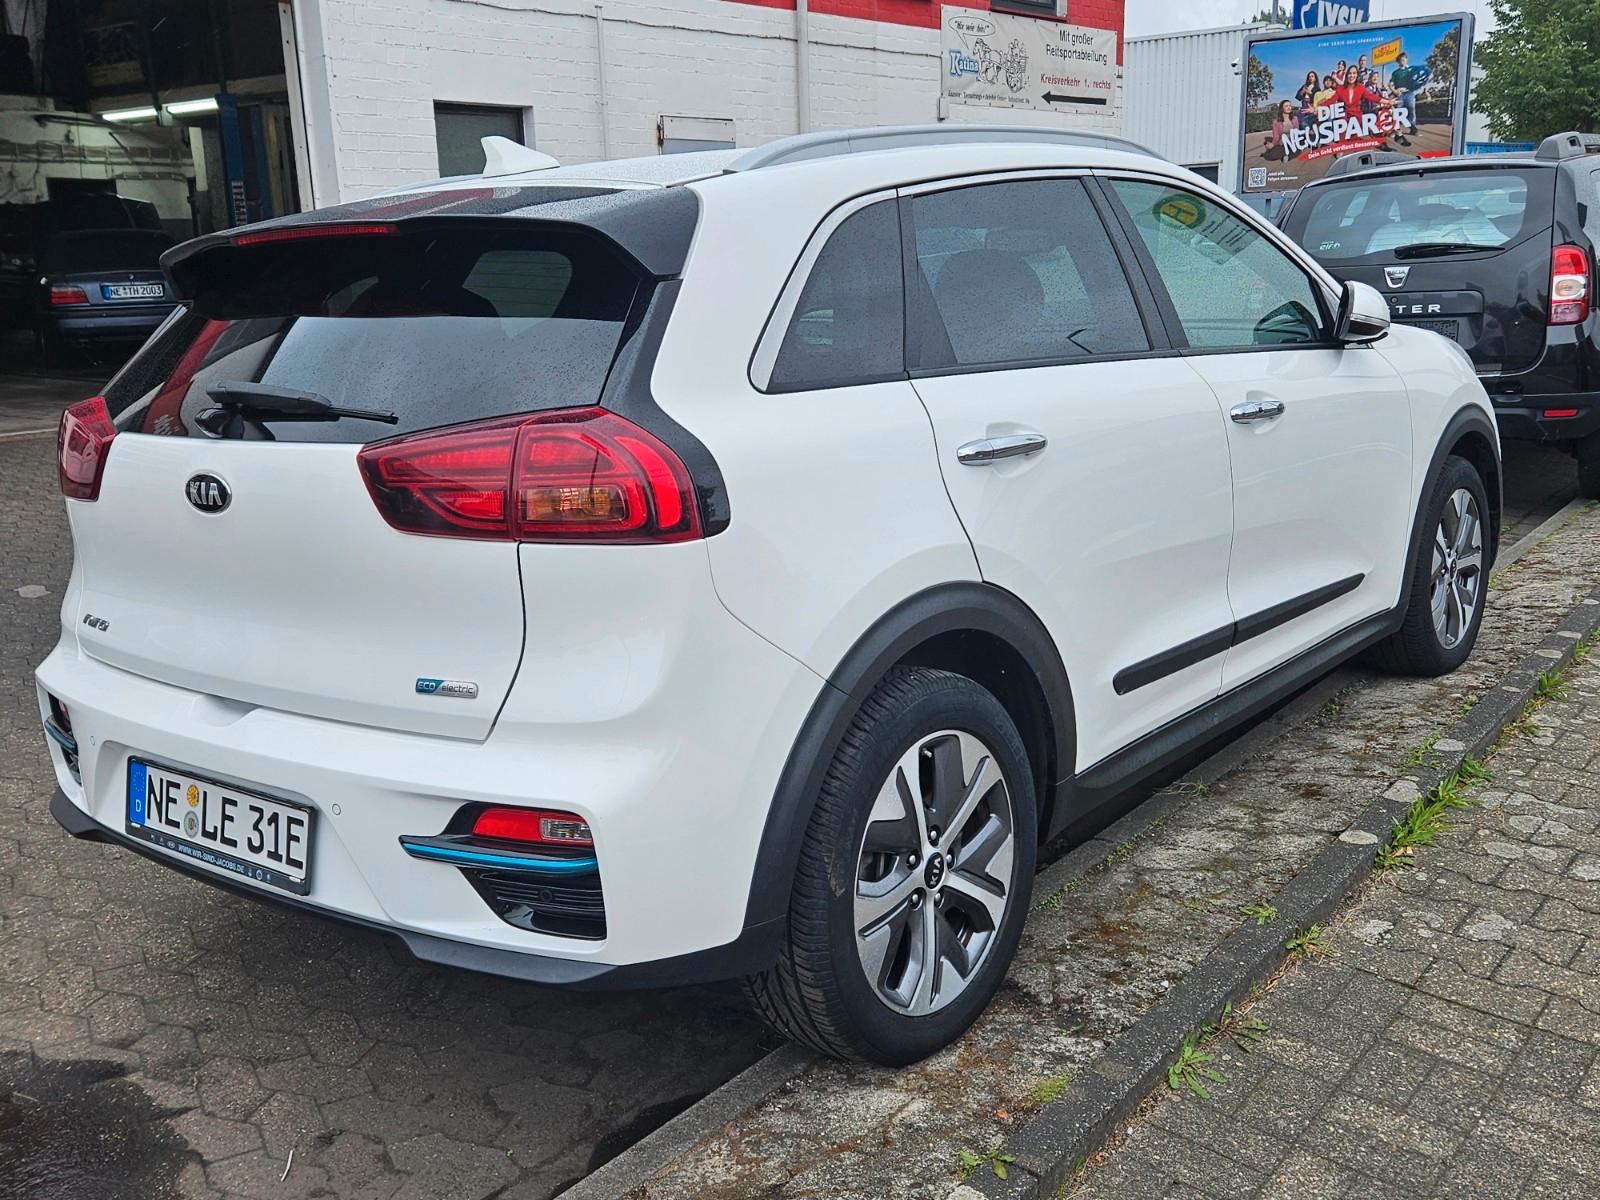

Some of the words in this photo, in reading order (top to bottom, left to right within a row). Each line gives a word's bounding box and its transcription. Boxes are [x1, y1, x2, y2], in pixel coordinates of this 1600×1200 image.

[1059, 30, 1070, 42] Mit
[1071, 33, 1093, 46] großer
[1046, 43, 1107, 66] Reitsportabteilung
[1040, 73, 1081, 87] Kreisverkehr
[1092, 79, 1112, 90] rechts
[1317, 102, 1346, 122] DIE
[1308, 151, 1320, 160] Dein
[1320, 148, 1332, 156] Geld
[1354, 140, 1379, 149] Besseres.
[110, 287, 121, 297] NE
[127, 286, 140, 296] TH
[140, 285, 162, 296] 2003
[1388, 303, 1441, 314] TER
[189, 481, 223, 506] KIA
[441, 683, 474, 694] electric
[135, 799, 142, 812] D
[147, 774, 181, 830] NE
[201, 790, 238, 848] LE
[247, 804, 305, 870] 31E
[929, 857, 941, 886] KIA
